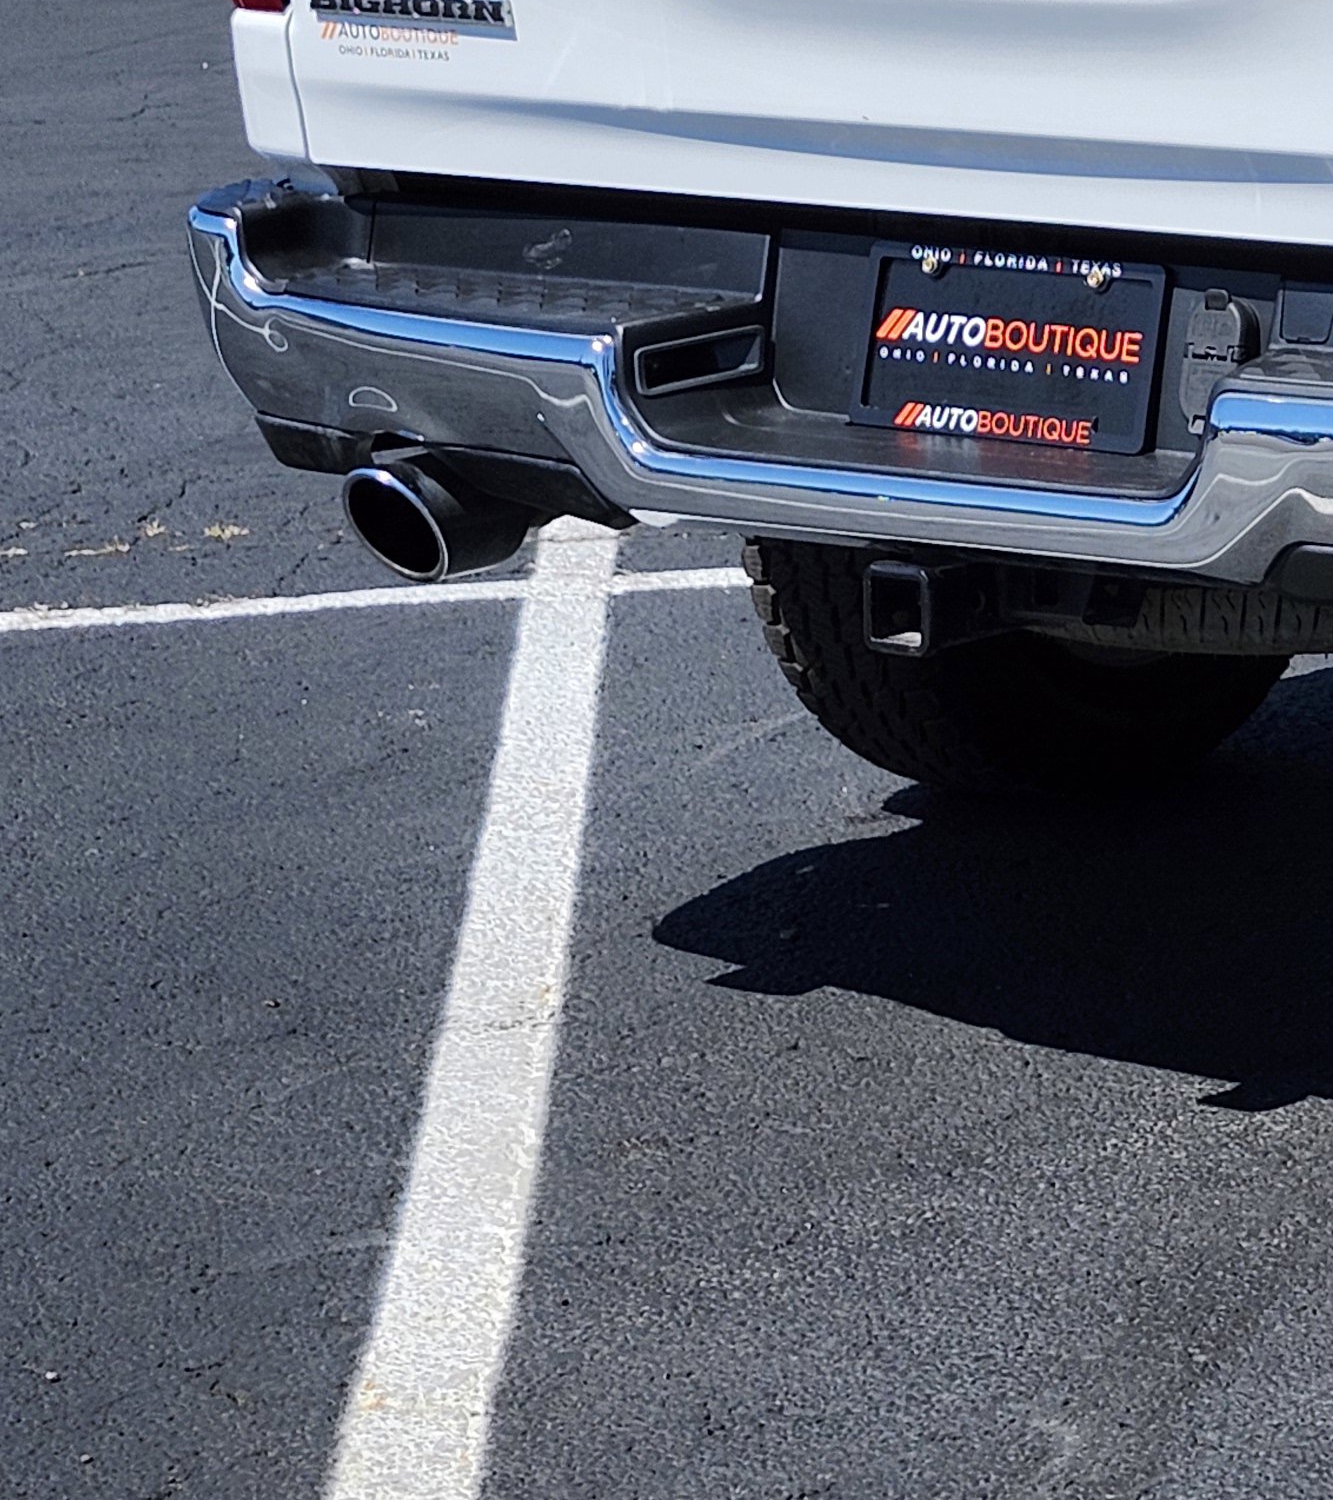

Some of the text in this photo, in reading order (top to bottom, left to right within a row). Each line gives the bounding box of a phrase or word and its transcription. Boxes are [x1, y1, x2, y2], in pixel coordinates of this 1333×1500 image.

[338, 44, 450, 62] OHIO FLORIDA TEXAS
[911, 244, 1123, 278] OHIO FLORIDA TEXAS
[878, 345, 1130, 385] OHIO FLORIDA TEXAS
